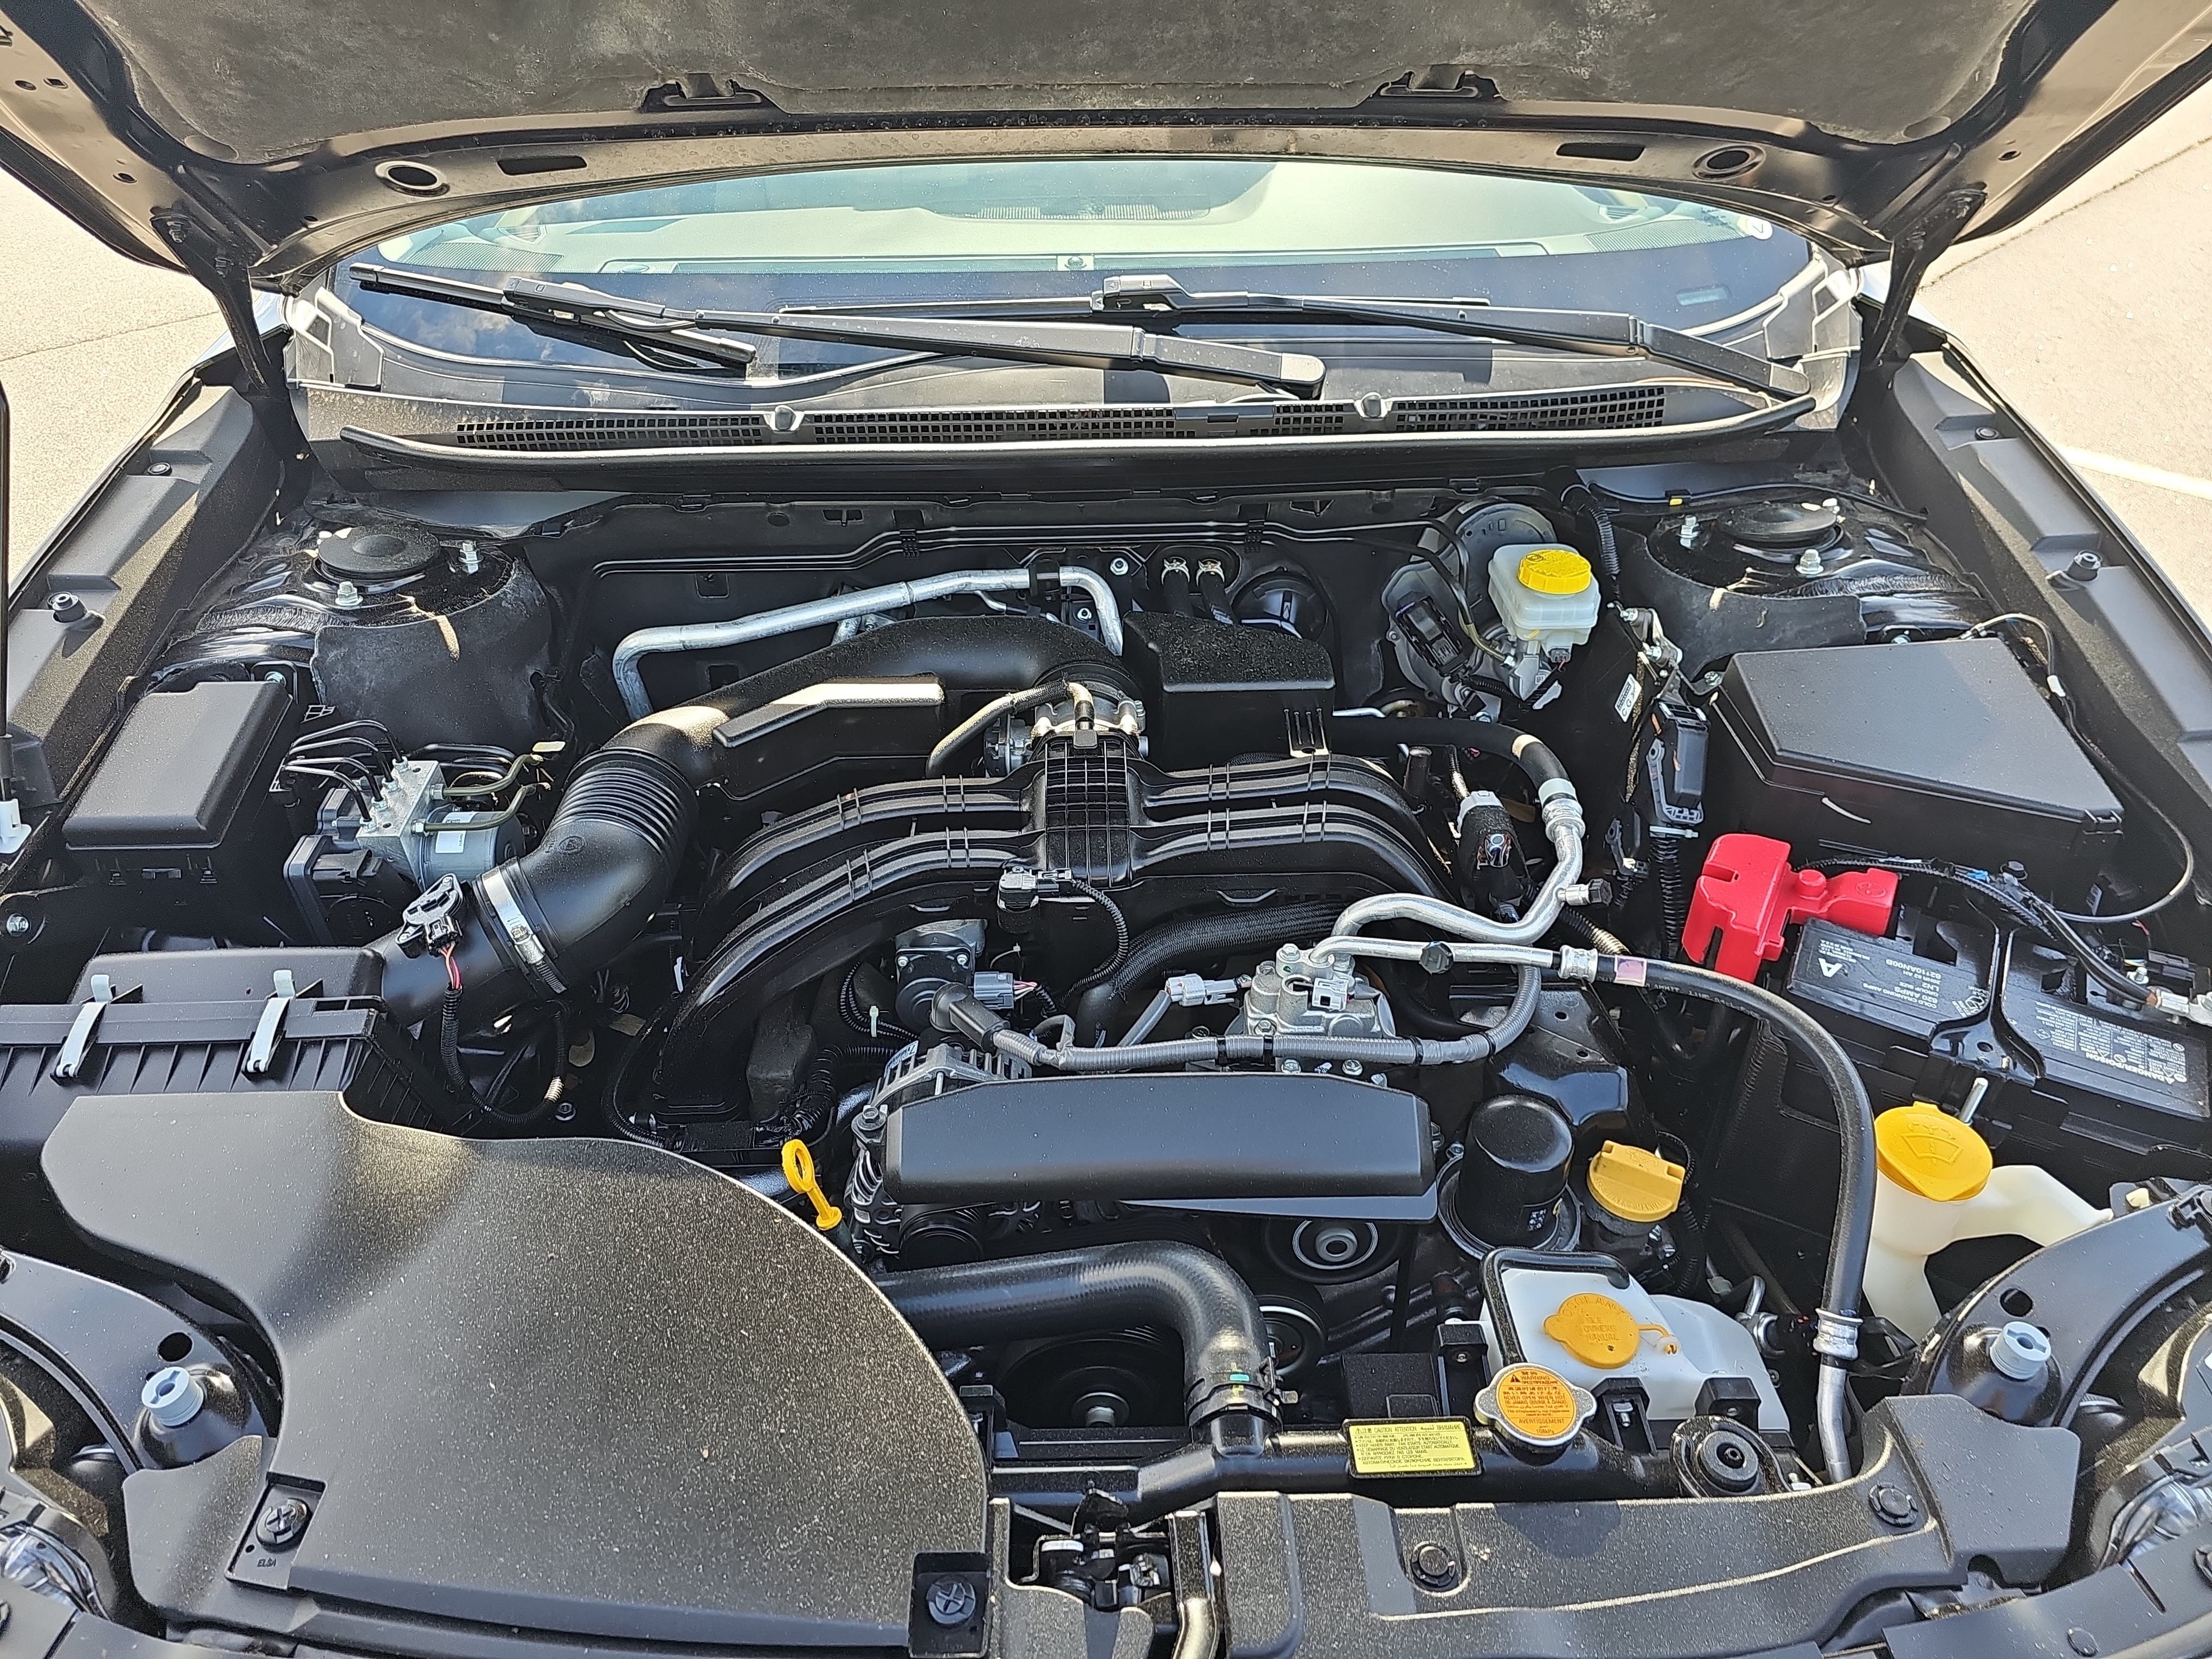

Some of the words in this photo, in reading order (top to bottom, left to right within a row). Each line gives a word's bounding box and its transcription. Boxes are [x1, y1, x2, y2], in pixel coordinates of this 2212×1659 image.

[1886, 960, 1941, 979] 82110AN00B
[1863, 982, 1882, 992] AMPS
[1899, 981, 1914, 989] SIZE
[1922, 982, 1939, 992] LN2
[1894, 986, 1921, 998] AMPS
[1915, 987, 1939, 997] GROUP
[1918, 1000, 1937, 1008] COLD
[1922, 995, 1938, 1003] 620
[1594, 1178, 1606, 1191] SEE
[1636, 1201, 1665, 1211] MANUAL
